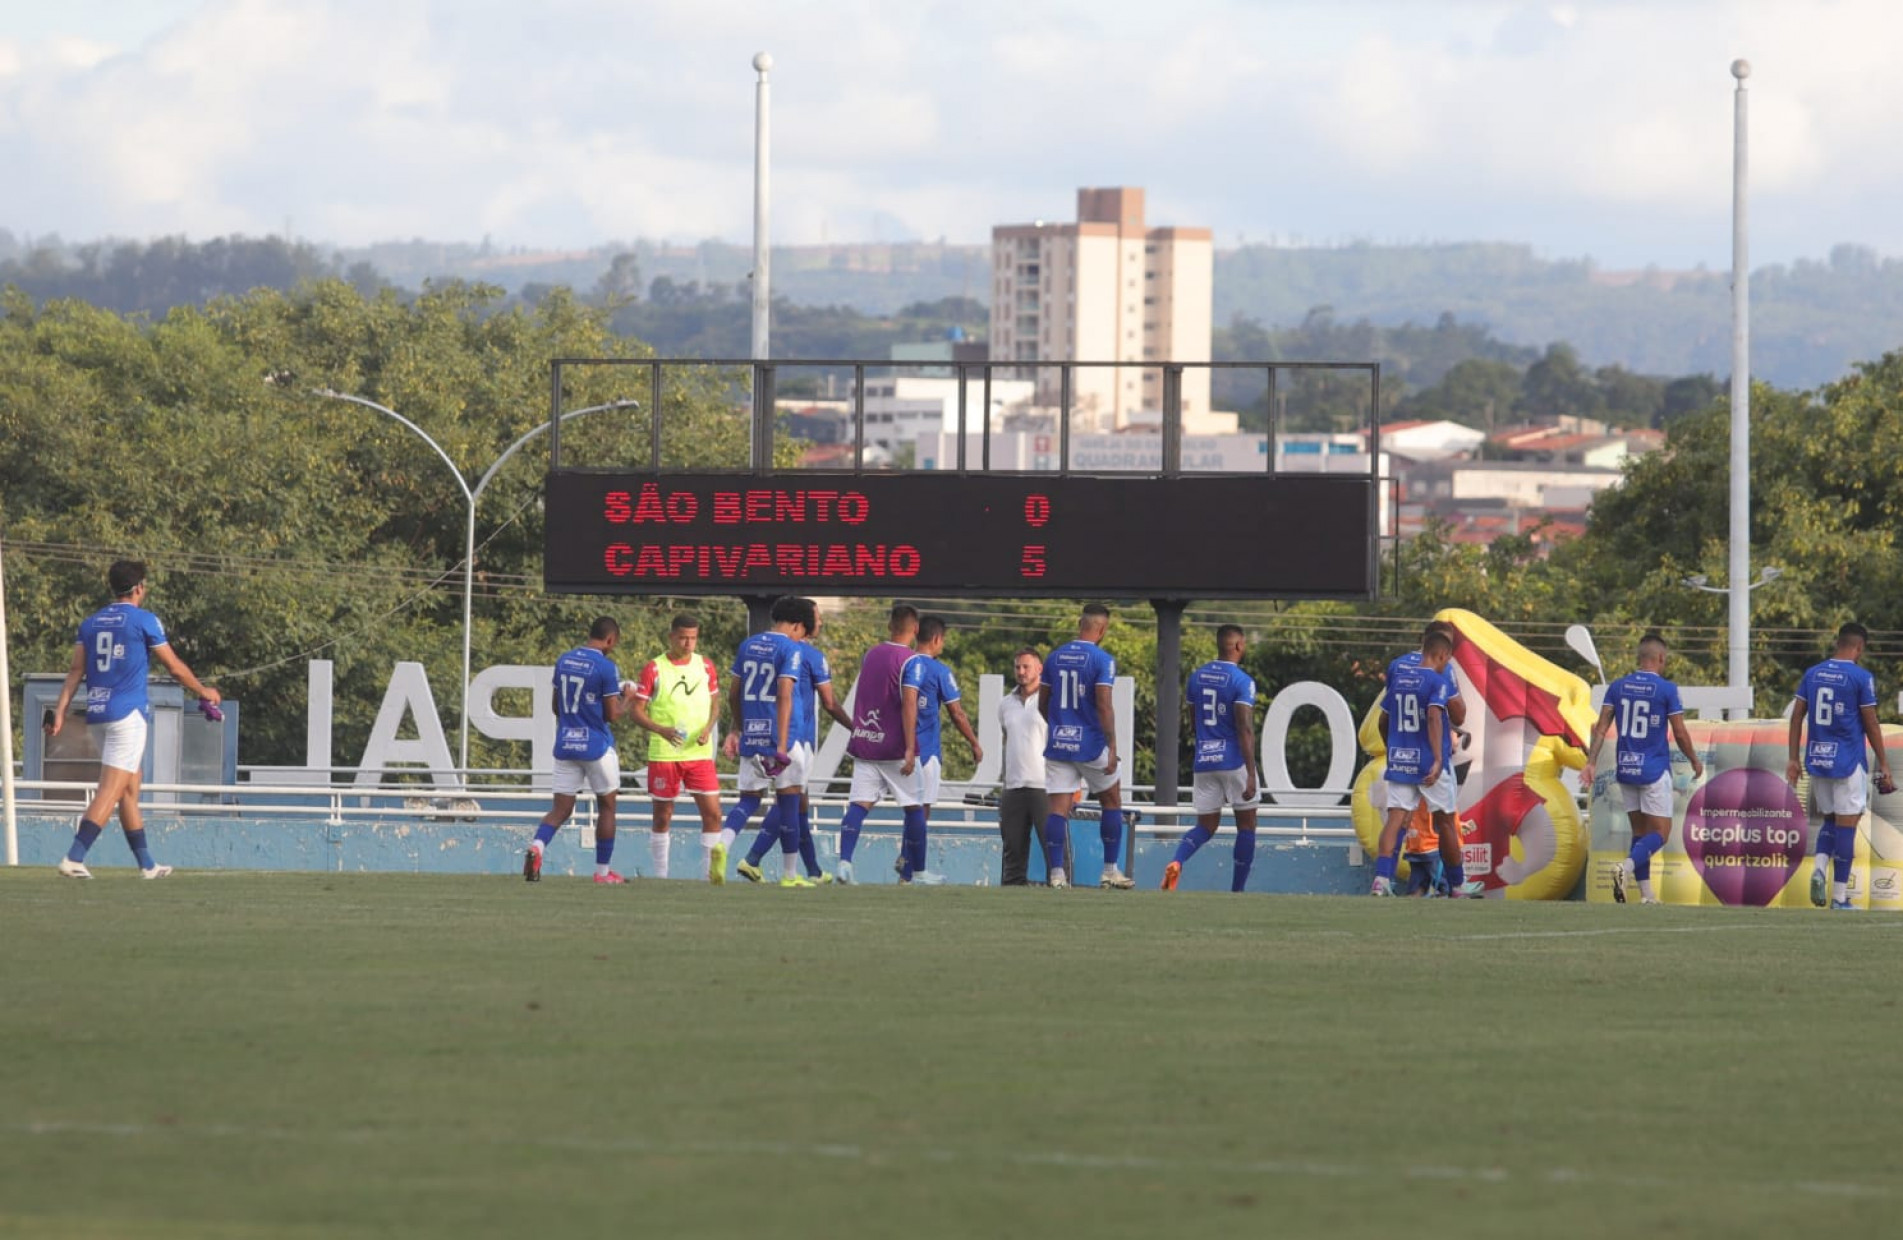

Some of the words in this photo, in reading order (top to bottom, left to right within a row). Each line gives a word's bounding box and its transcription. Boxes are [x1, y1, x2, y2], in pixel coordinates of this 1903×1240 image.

[604, 483, 698, 524] SÃO
[714, 490, 870, 526] BENTO
[604, 543, 922, 578] CAPIVARIANO
[1021, 545, 1046, 578] 5
[96, 631, 113, 673] 9
[560, 673, 585, 714] 17
[743, 660, 777, 702] 22
[1059, 669, 1079, 710] 11
[1202, 688, 1218, 726] 3
[1395, 693, 1420, 732] 19
[1620, 698, 1650, 739] 16
[1815, 686, 1835, 726] 6
[1699, 806, 1793, 820] Impermeabilizante
[1690, 823, 1762, 847] tecplus
[1766, 825, 1801, 848] top
[1704, 852, 1790, 870] quartzolit
